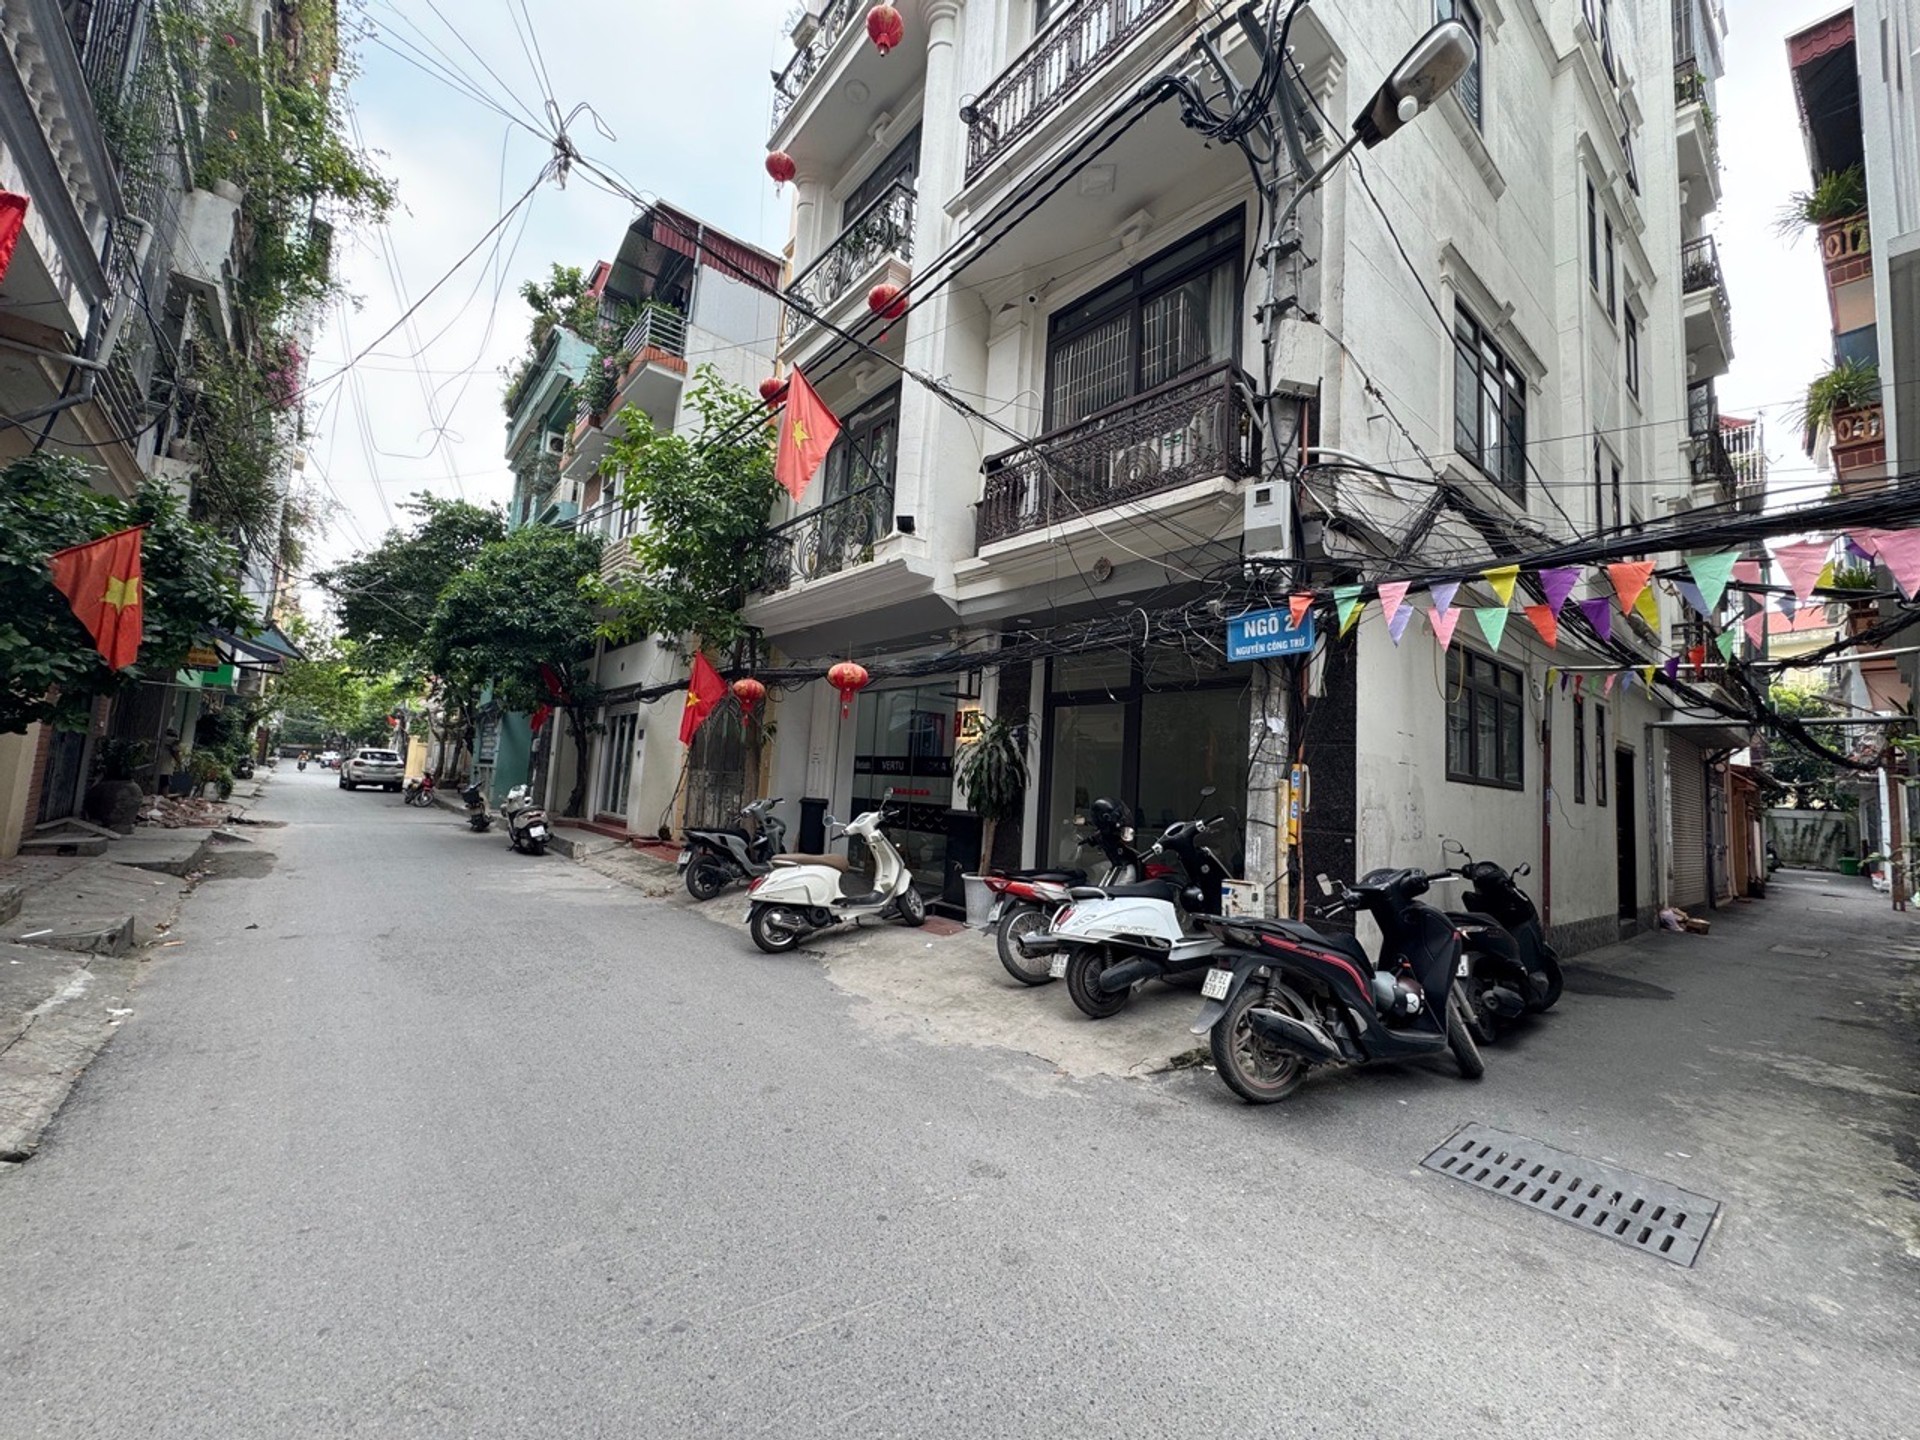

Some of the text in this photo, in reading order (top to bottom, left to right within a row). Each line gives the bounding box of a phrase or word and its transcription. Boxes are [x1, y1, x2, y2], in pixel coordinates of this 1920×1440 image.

[1244, 613, 1278, 638] NGÕ
[1267, 640, 1288, 651] CÔNG
[882, 761, 904, 771] VERTU
